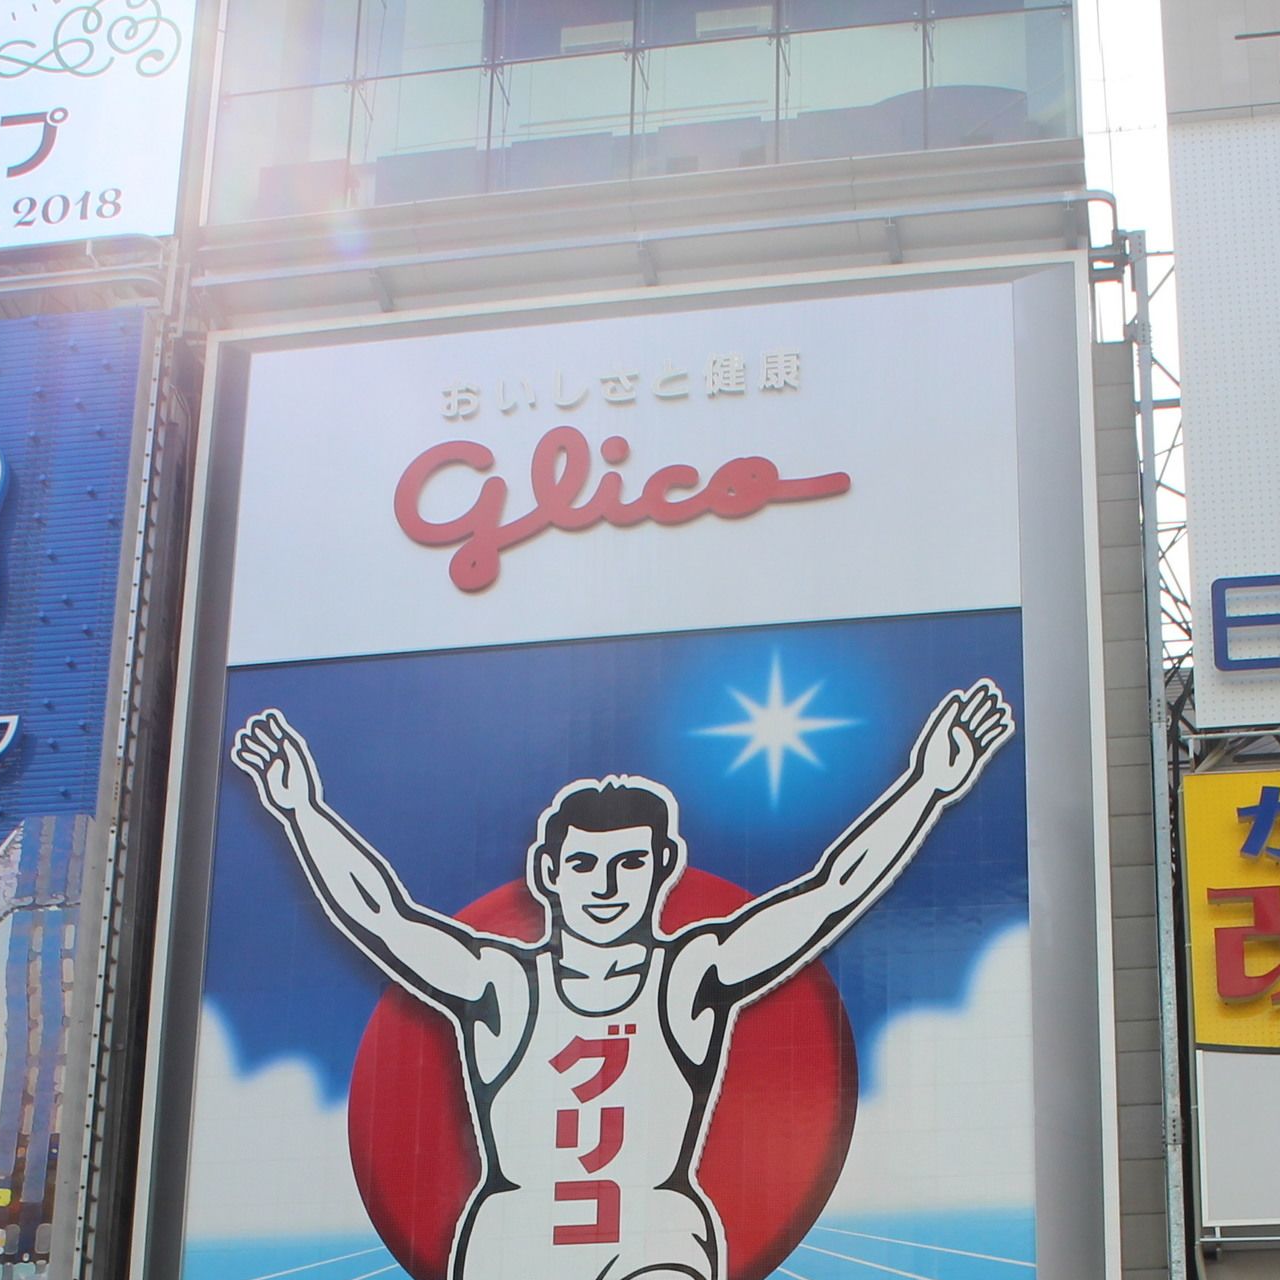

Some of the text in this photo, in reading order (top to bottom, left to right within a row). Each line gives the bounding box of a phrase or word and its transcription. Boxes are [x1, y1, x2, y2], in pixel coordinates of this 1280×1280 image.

[13, 188, 123, 227] 2018
[439, 346, 802, 421] おいしさと健康
[394, 426, 851, 593] Glico
[548, 1024, 636, 1246] グリコ
